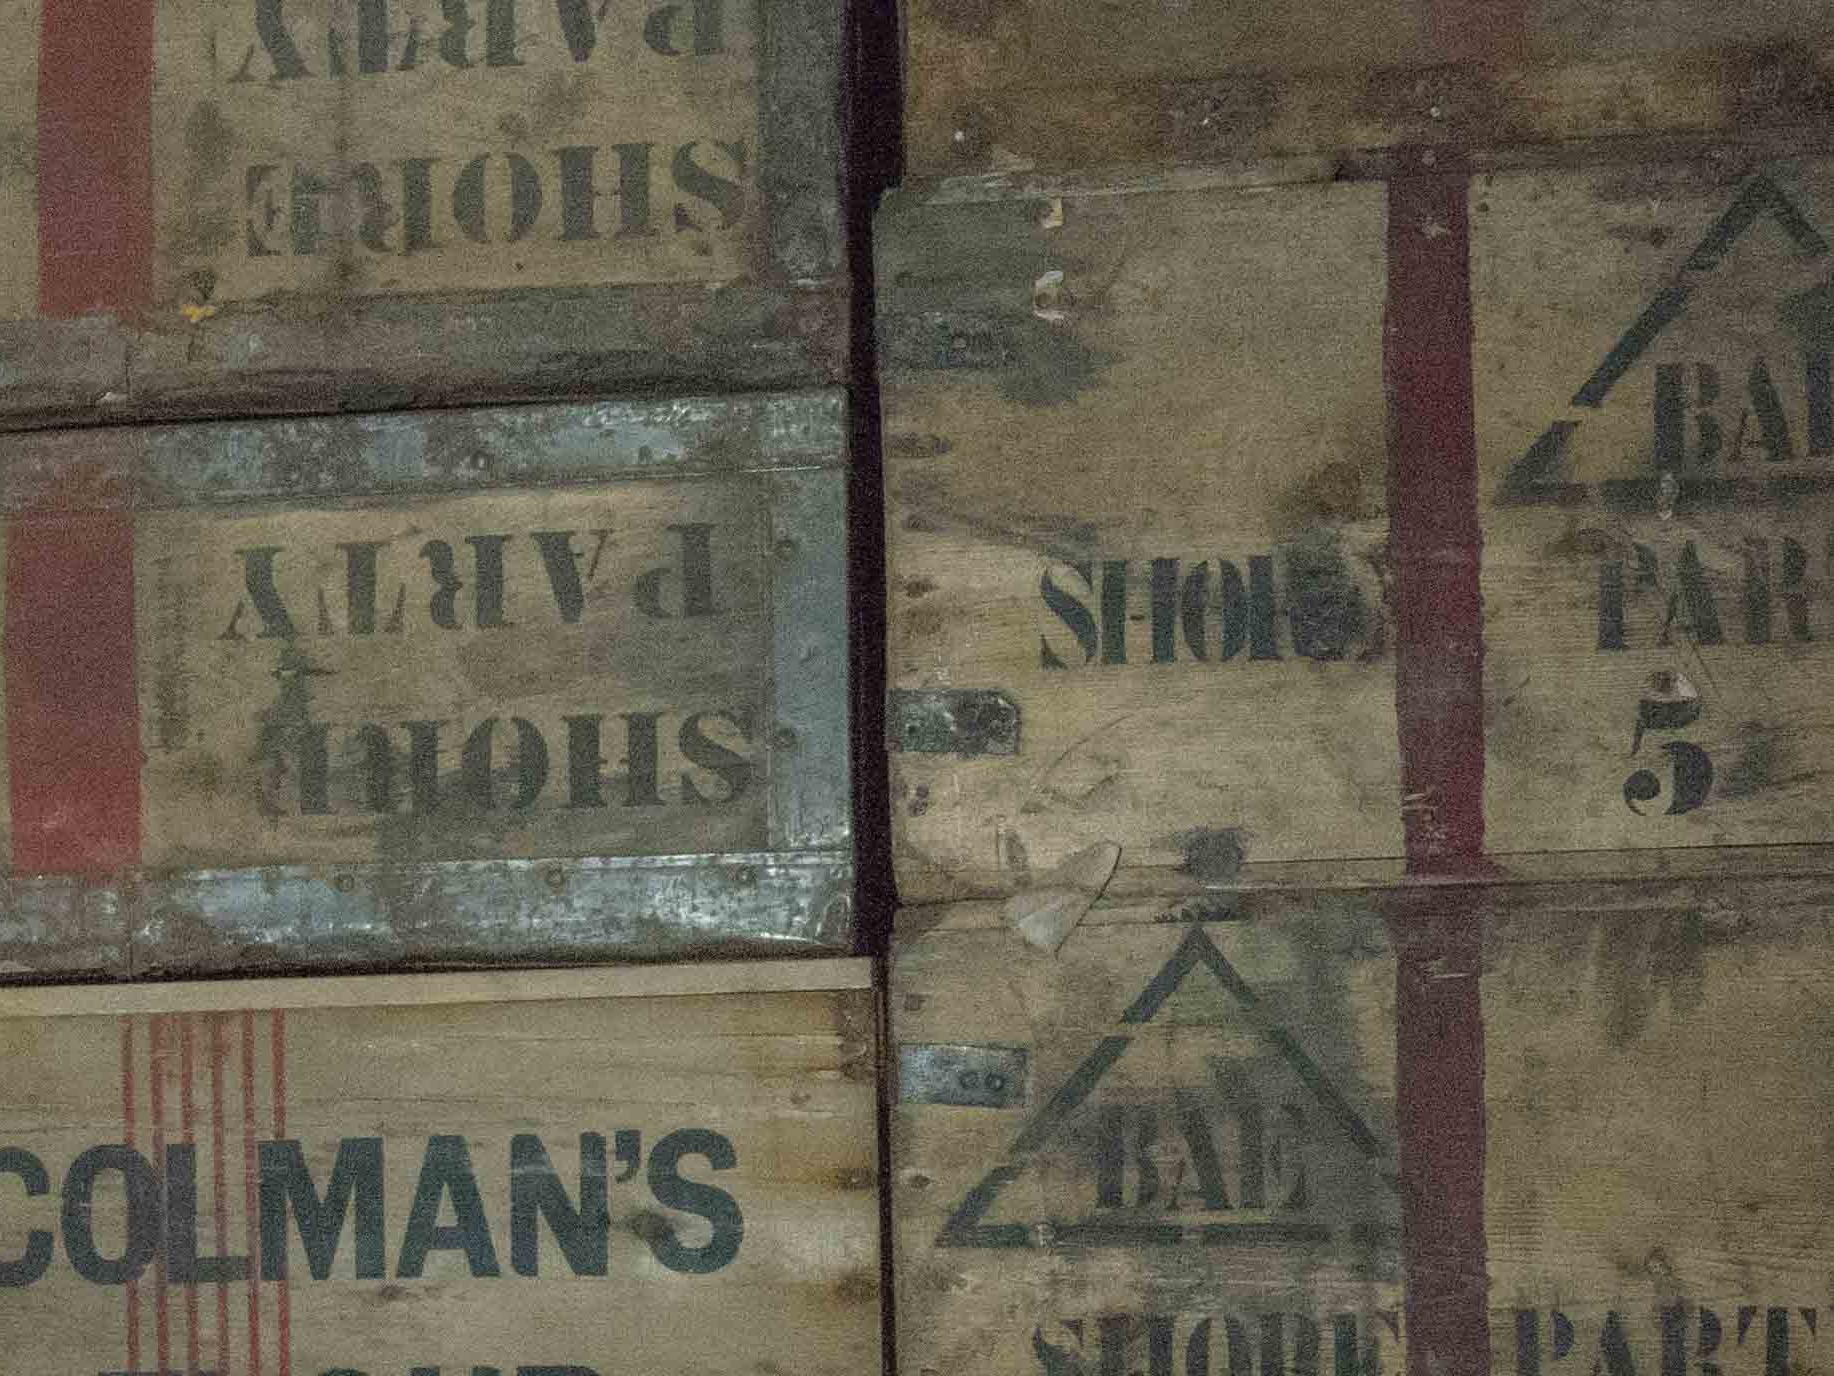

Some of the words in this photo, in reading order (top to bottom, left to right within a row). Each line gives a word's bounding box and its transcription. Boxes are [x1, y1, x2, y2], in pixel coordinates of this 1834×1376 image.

[244, 138, 752, 260] SHORE
[218, 522, 728, 640] PARTY
[1596, 535, 1834, 652] PAR
[254, 708, 756, 816] SHORE
[1622, 672, 1715, 818] 5
[1090, 1100, 1308, 1210] BAE
